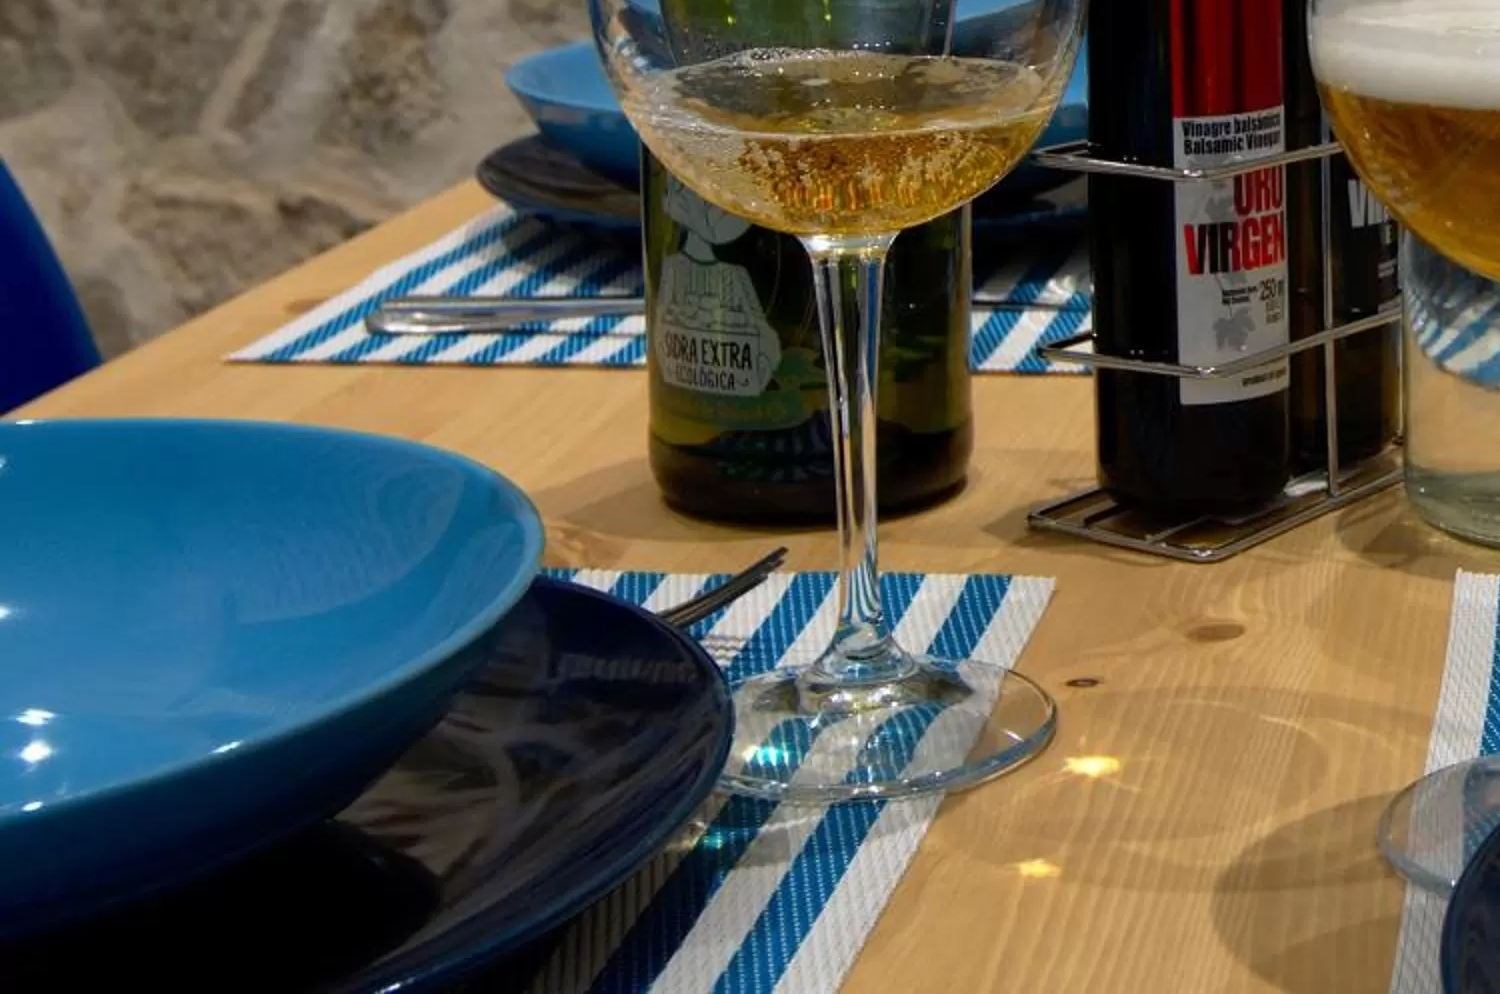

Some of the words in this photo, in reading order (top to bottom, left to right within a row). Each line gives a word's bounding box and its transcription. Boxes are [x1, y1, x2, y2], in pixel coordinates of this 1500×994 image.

[1182, 119, 1231, 138] Vinagre
[1183, 135, 1244, 155] Balsamic
[1183, 211, 1285, 275] VIRGEN
[701, 338, 753, 370] EXTRA
